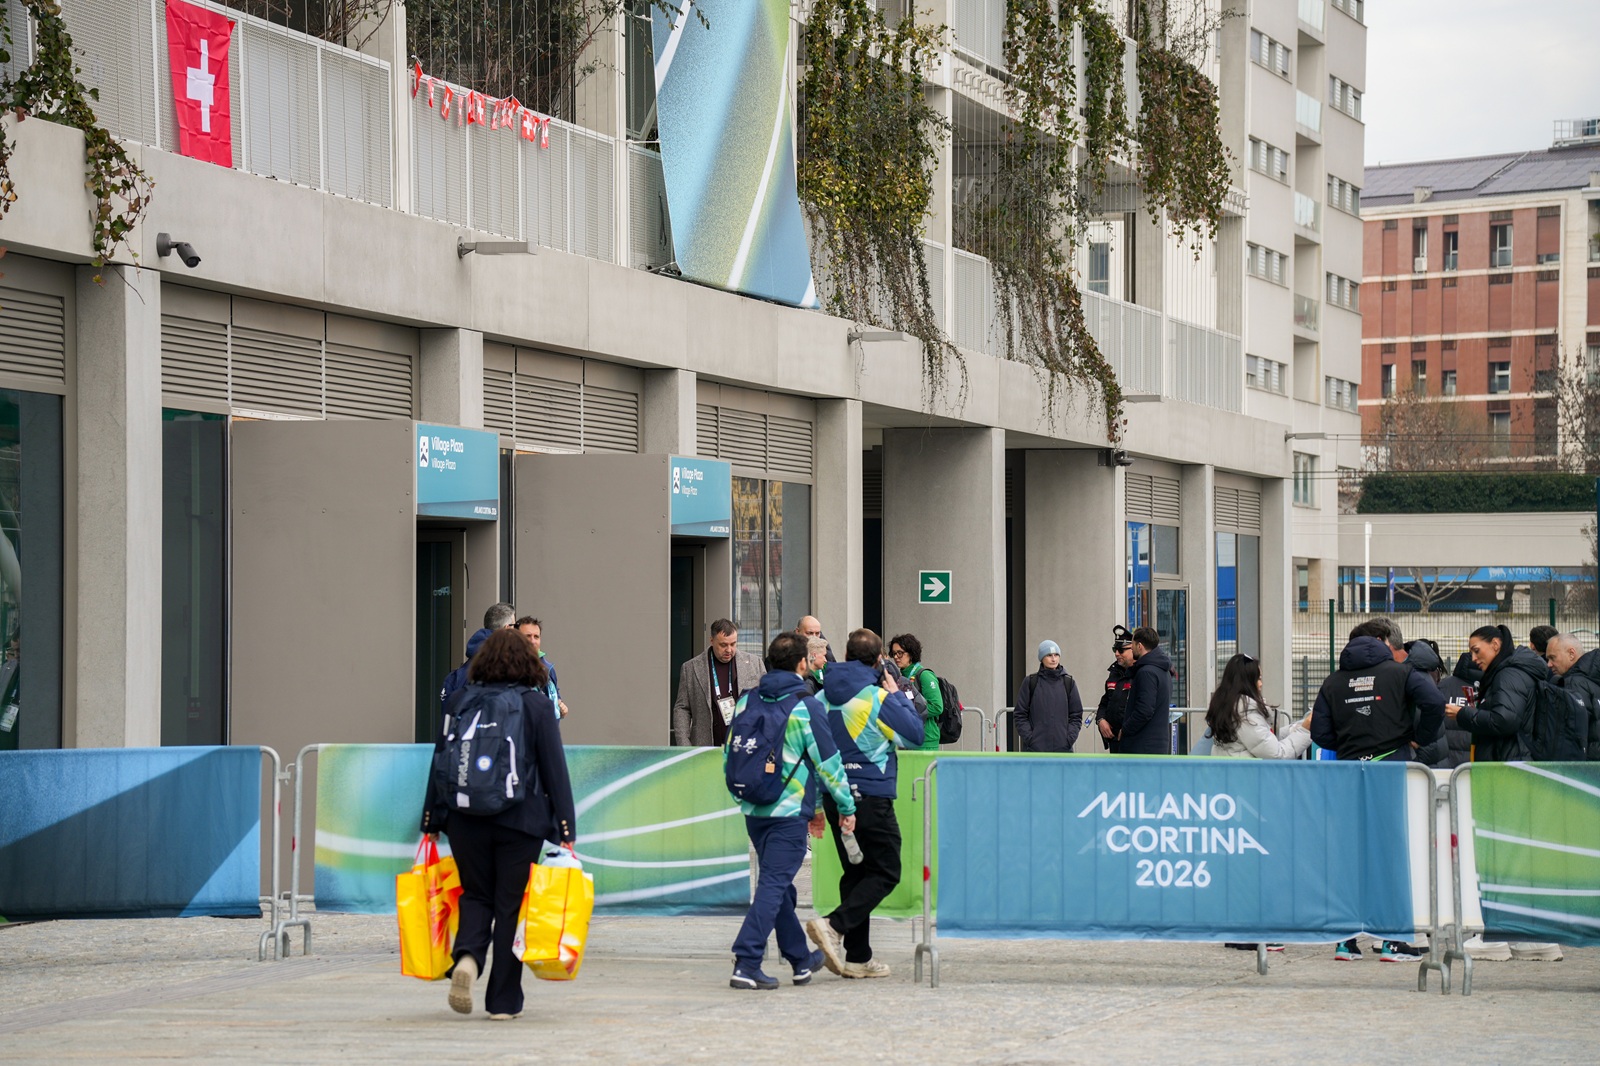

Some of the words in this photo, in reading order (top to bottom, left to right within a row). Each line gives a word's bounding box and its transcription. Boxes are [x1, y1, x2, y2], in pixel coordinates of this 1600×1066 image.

[431, 436, 450, 456] Village
[450, 438, 464, 453] Plaza
[431, 458, 445, 472] Village
[446, 459, 456, 470] Plaza
[681, 467, 693, 483] Village
[458, 741, 471, 787] FINLAND
[1076, 791, 1236, 821] MILANO
[1105, 824, 1270, 855] CORTINA
[1135, 859, 1212, 888] 2026
